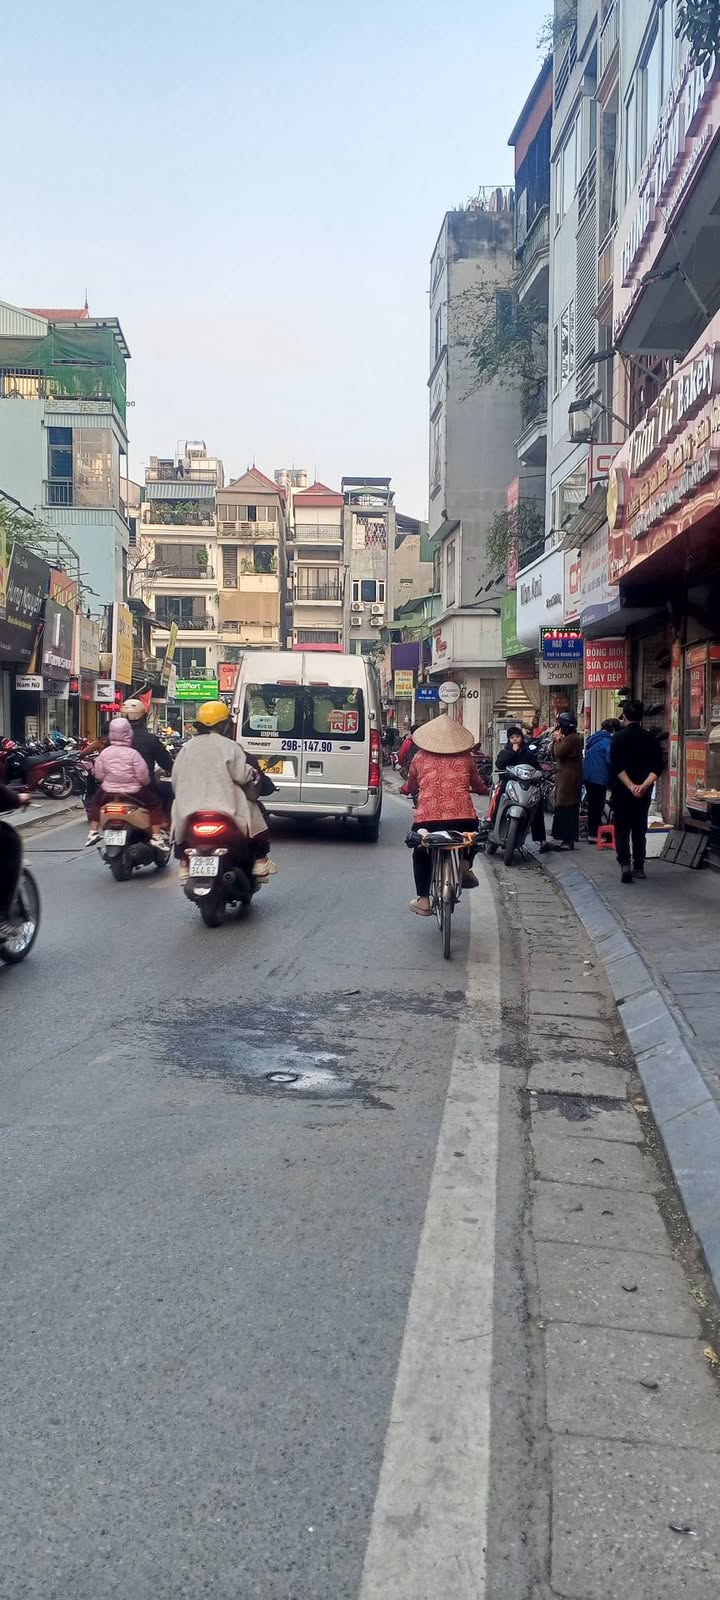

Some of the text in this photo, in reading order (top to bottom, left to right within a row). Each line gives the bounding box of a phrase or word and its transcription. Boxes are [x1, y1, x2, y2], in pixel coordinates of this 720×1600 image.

[676, 351, 715, 421] Bakery
[543, 661, 577, 669] Mon Ami
[547, 672, 573, 680] 2hand
[467, 690, 479, 699] 60
